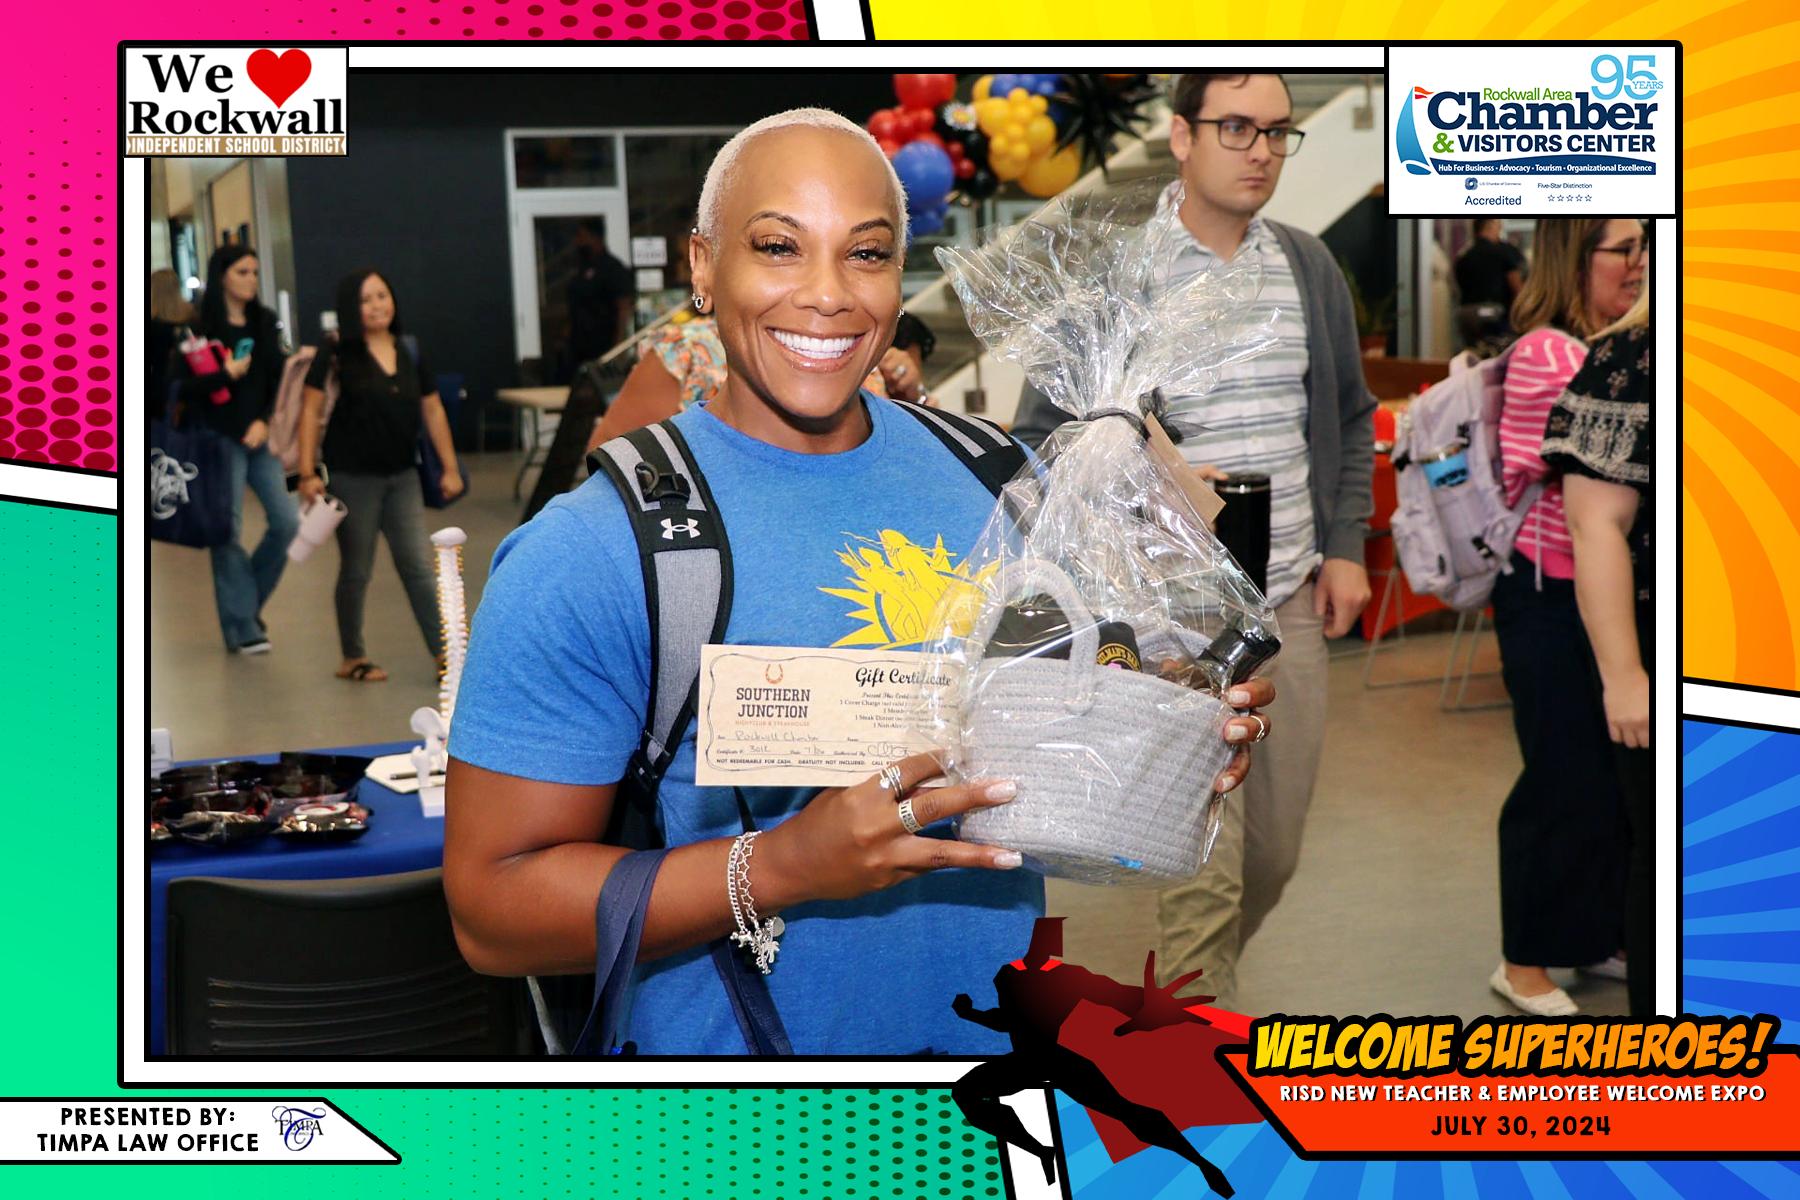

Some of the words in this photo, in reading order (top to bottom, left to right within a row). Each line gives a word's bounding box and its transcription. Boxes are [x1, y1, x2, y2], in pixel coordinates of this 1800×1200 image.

[855, 667, 885, 687] Gift
[736, 687, 811, 702] SOUTHERN
[737, 704, 809, 718] JUNCTION
